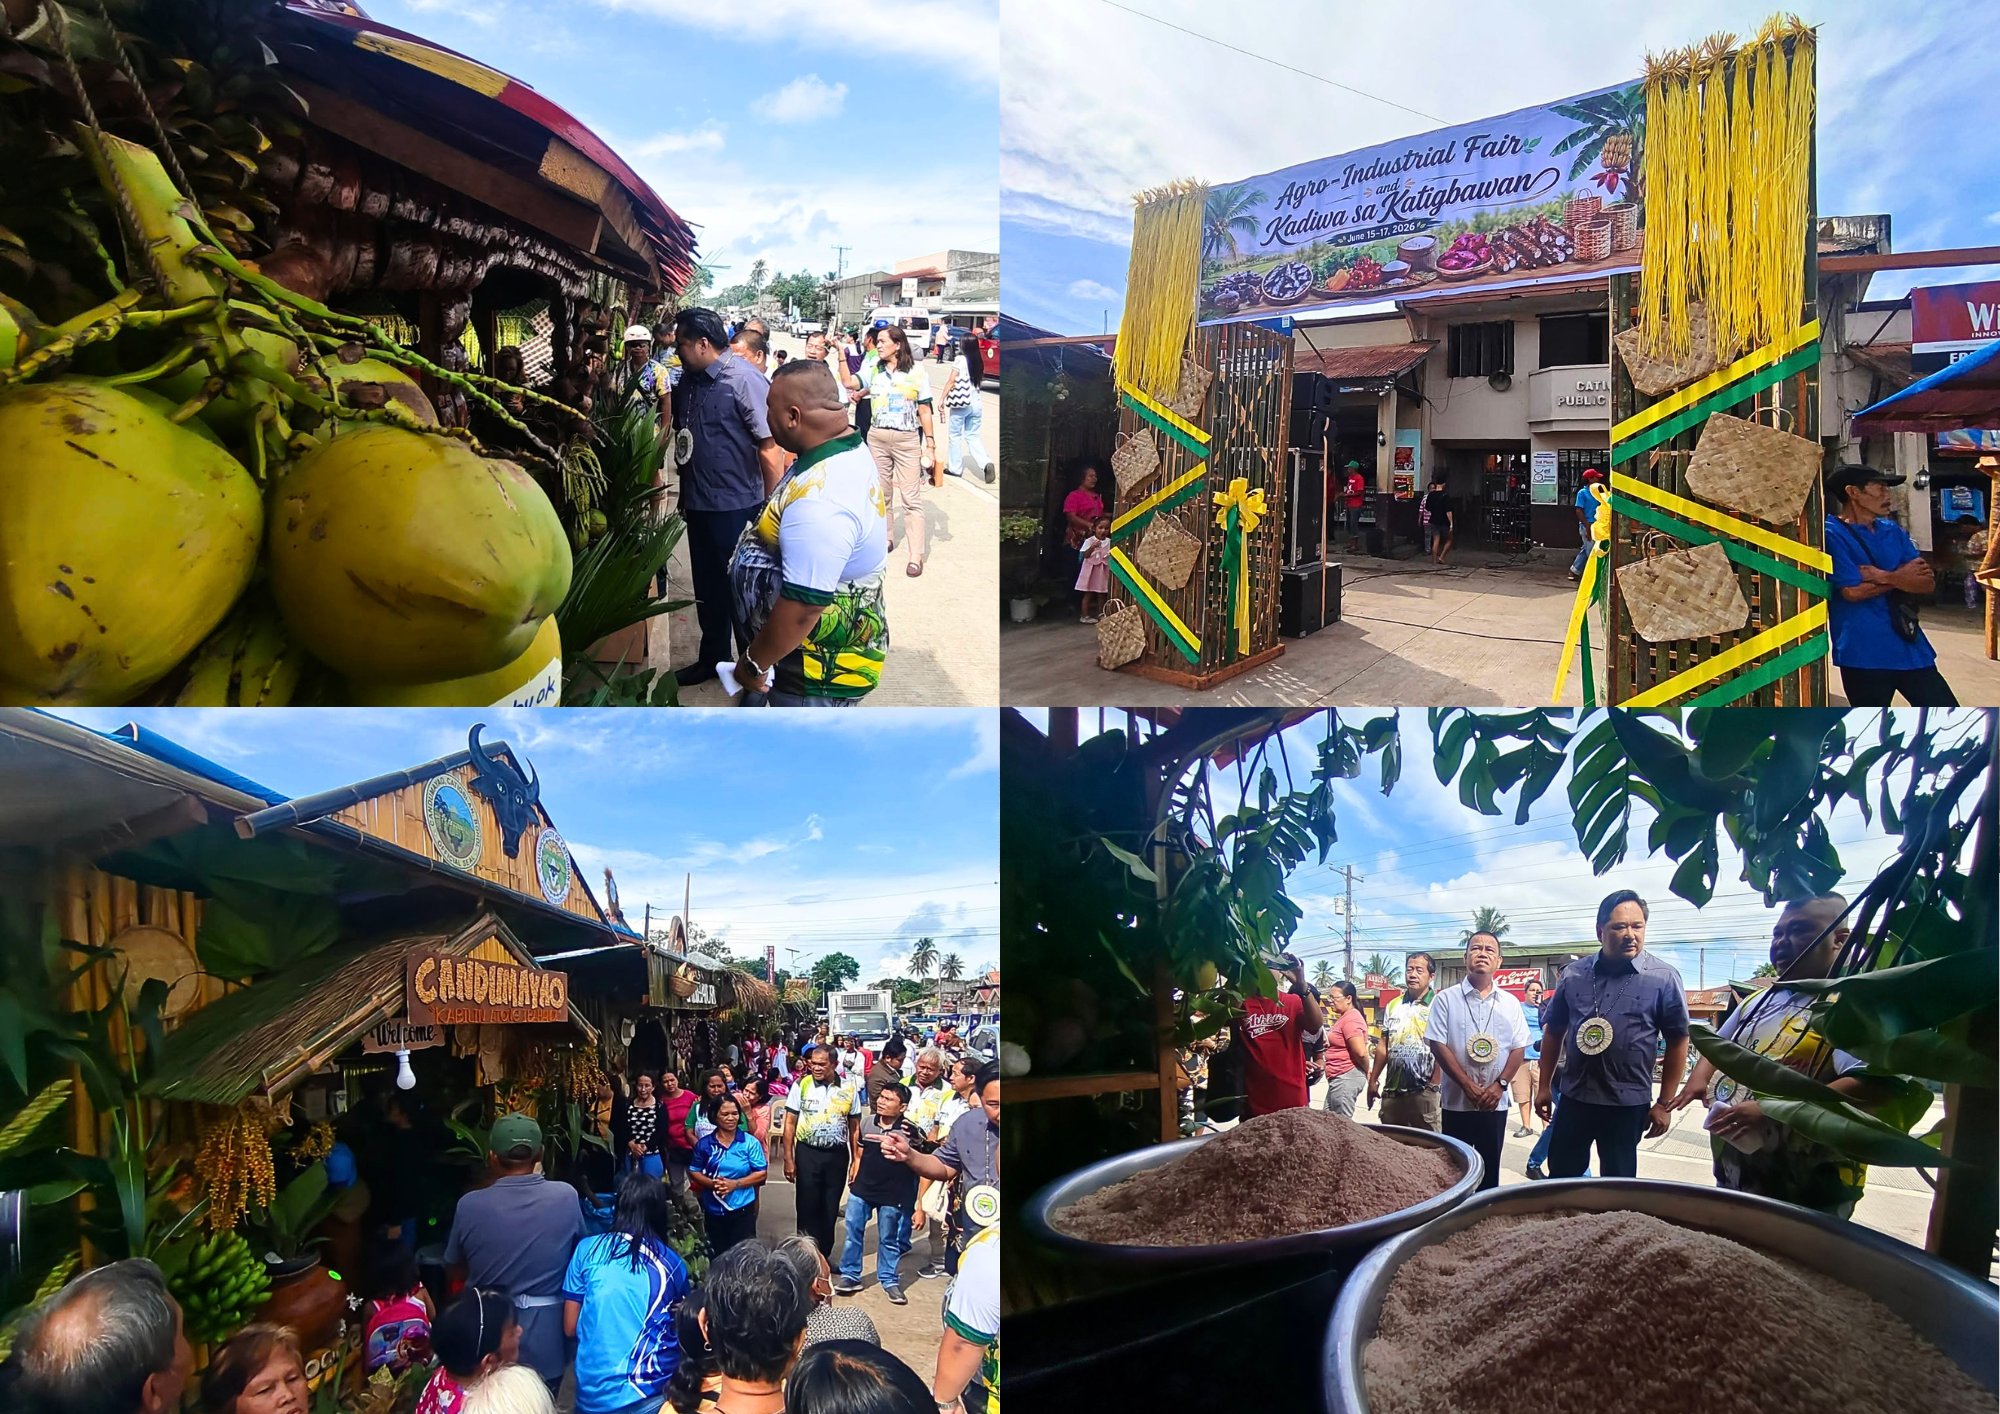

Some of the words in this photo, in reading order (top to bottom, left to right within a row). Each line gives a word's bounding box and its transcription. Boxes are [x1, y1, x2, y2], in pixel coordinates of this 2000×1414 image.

[1274, 140, 1456, 210] Agro-Industrial
[1463, 134, 1525, 162] Fair
[1376, 178, 1401, 196] and
[1260, 206, 1348, 246] Kadiwa
[1351, 203, 1378, 223] sa
[1378, 167, 1560, 222] Katigbawan
[1347, 231, 1365, 244] June
[1391, 221, 1416, 235] 2026
[1576, 381, 1611, 391] CATI
[1558, 395, 1606, 406] PUBLIC
[414, 957, 565, 1009] CANDUMAYAO
[372, 1022, 437, 1046] Welcome
